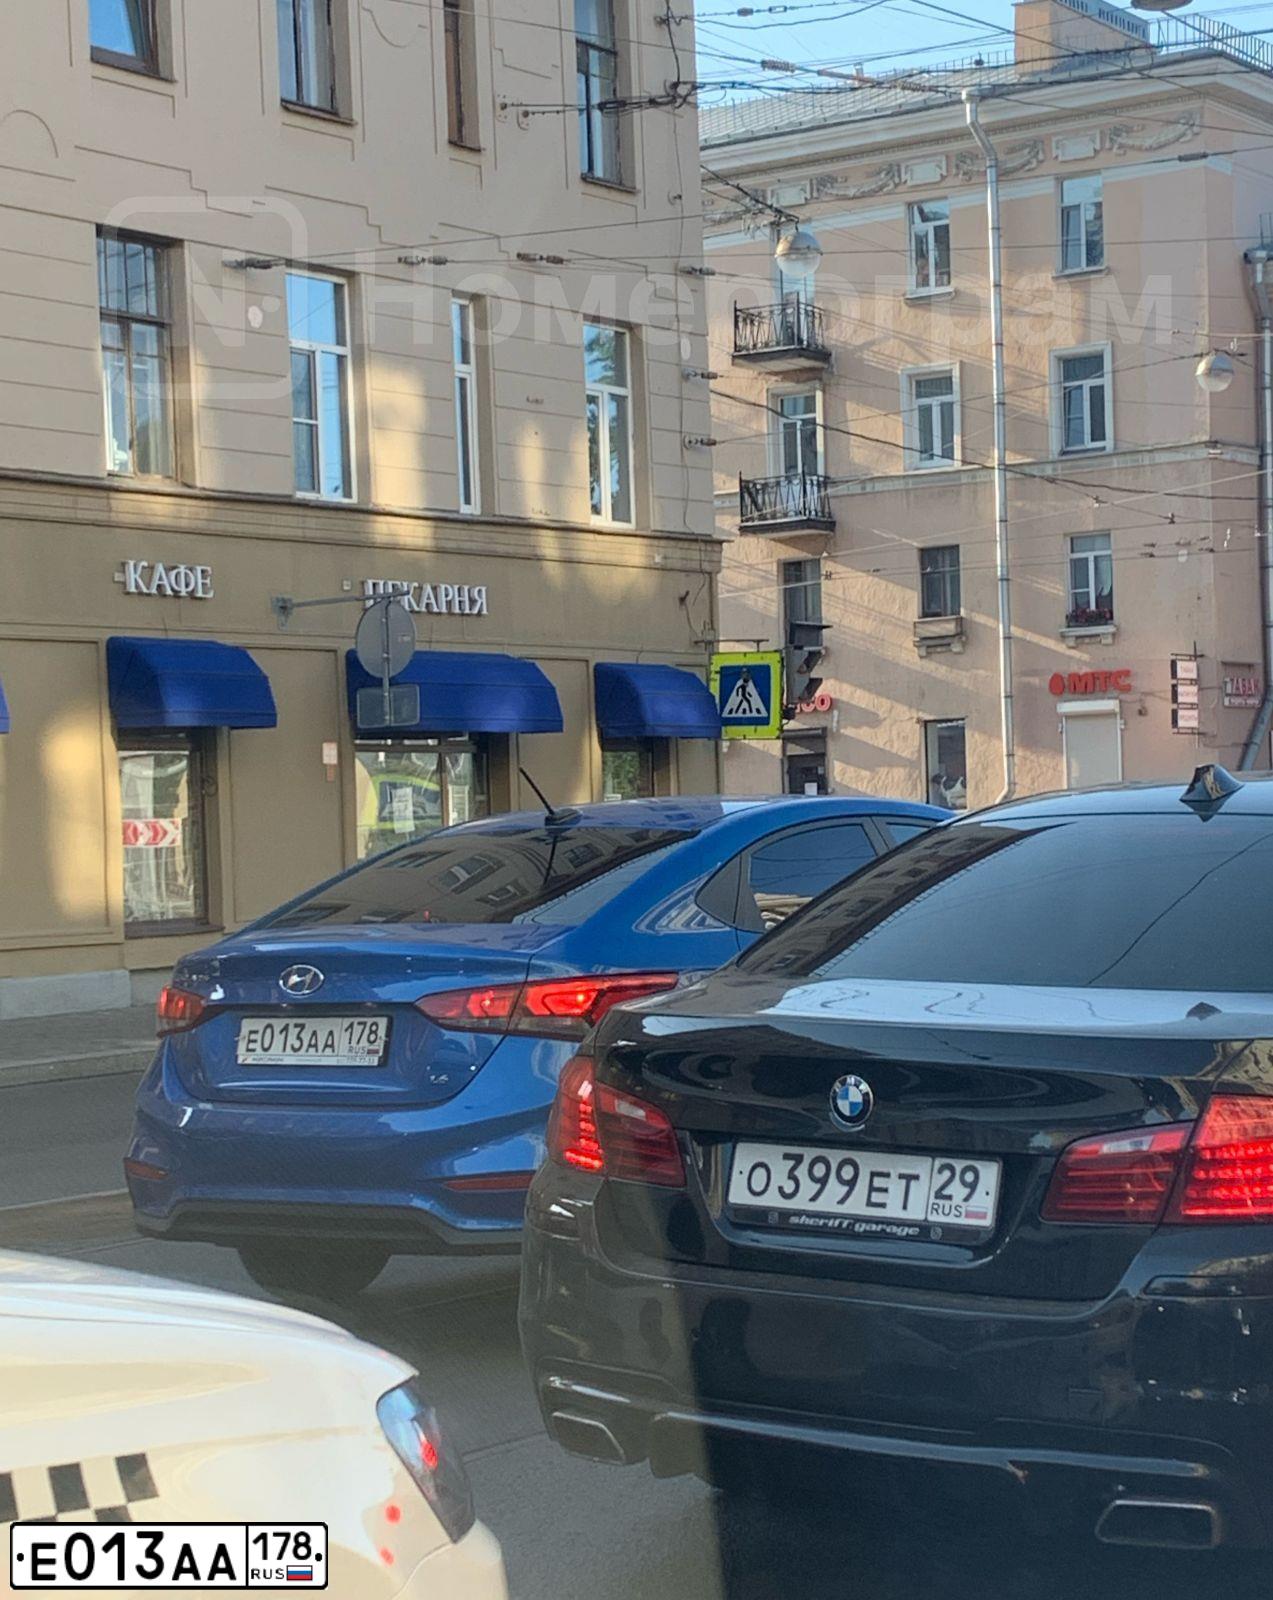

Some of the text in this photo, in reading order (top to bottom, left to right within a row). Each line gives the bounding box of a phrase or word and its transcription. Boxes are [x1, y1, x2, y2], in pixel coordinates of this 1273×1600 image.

[124, 560, 214, 599] КАФЕ
[1068, 669, 1132, 694] МТС
[245, 1020, 380, 1054] Е013АА 178
[347, 1045, 367, 1055] RUS
[746, 1152, 980, 1211] О399ЕТ 29
[930, 1203, 963, 1218] RUS
[854, 1221, 920, 1236] garage
